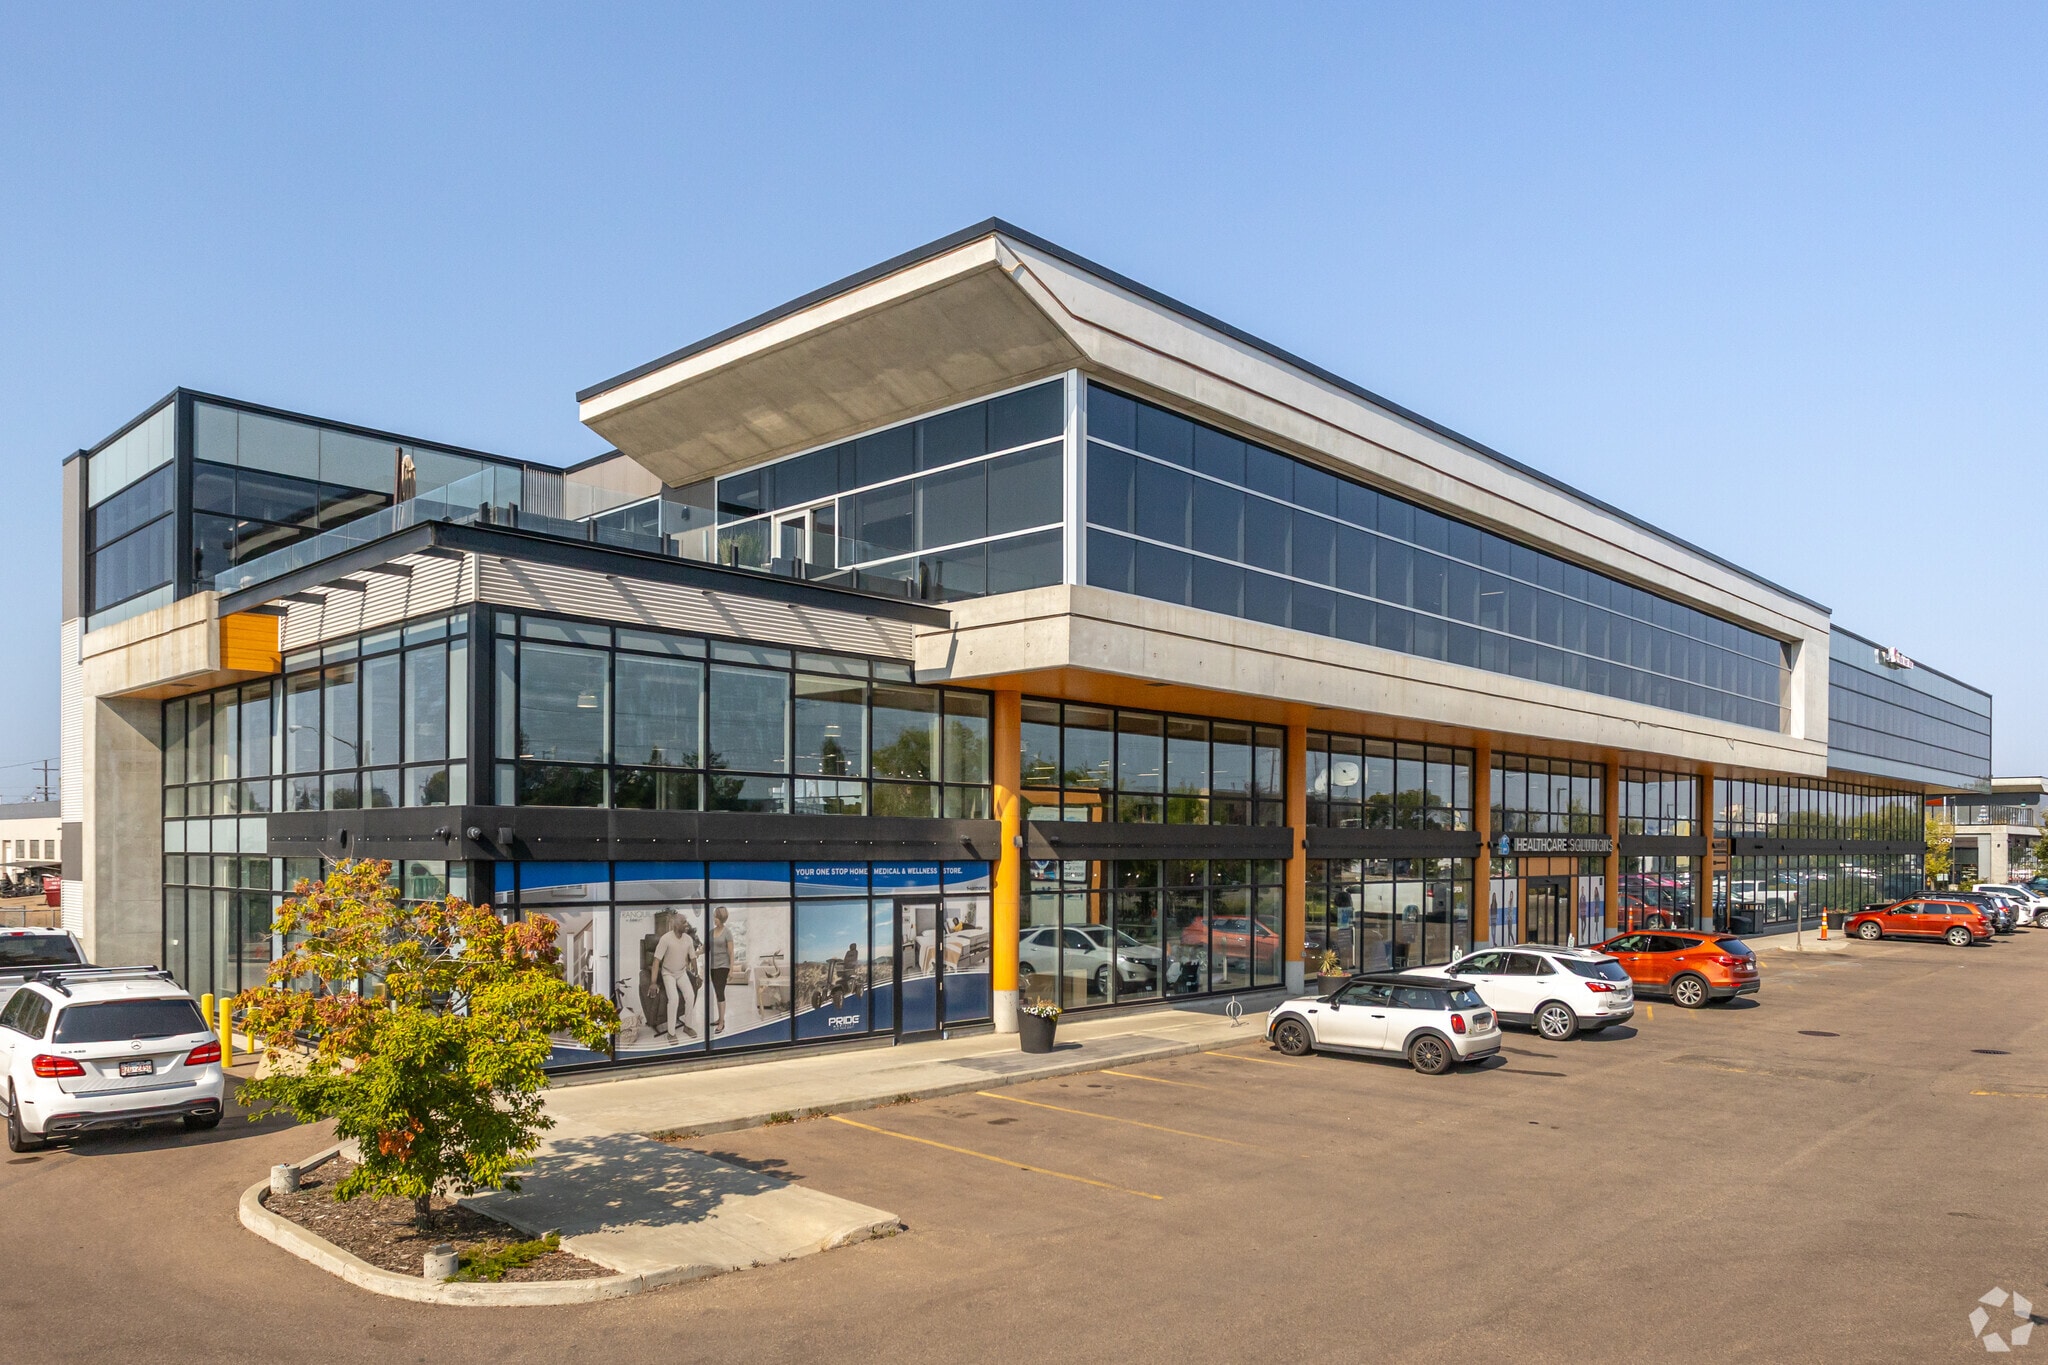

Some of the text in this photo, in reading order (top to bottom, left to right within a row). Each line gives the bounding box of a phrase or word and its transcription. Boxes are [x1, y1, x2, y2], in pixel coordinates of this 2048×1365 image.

[1514, 838, 1568, 852] HEALTHCARE
[1569, 838, 1613, 852] SOLUTIONS
[795, 867, 963, 876] YOUR ONE STOP HOME MEDICAL & WELLNESS STORE.
[828, 1015, 860, 1026] PRIDE
